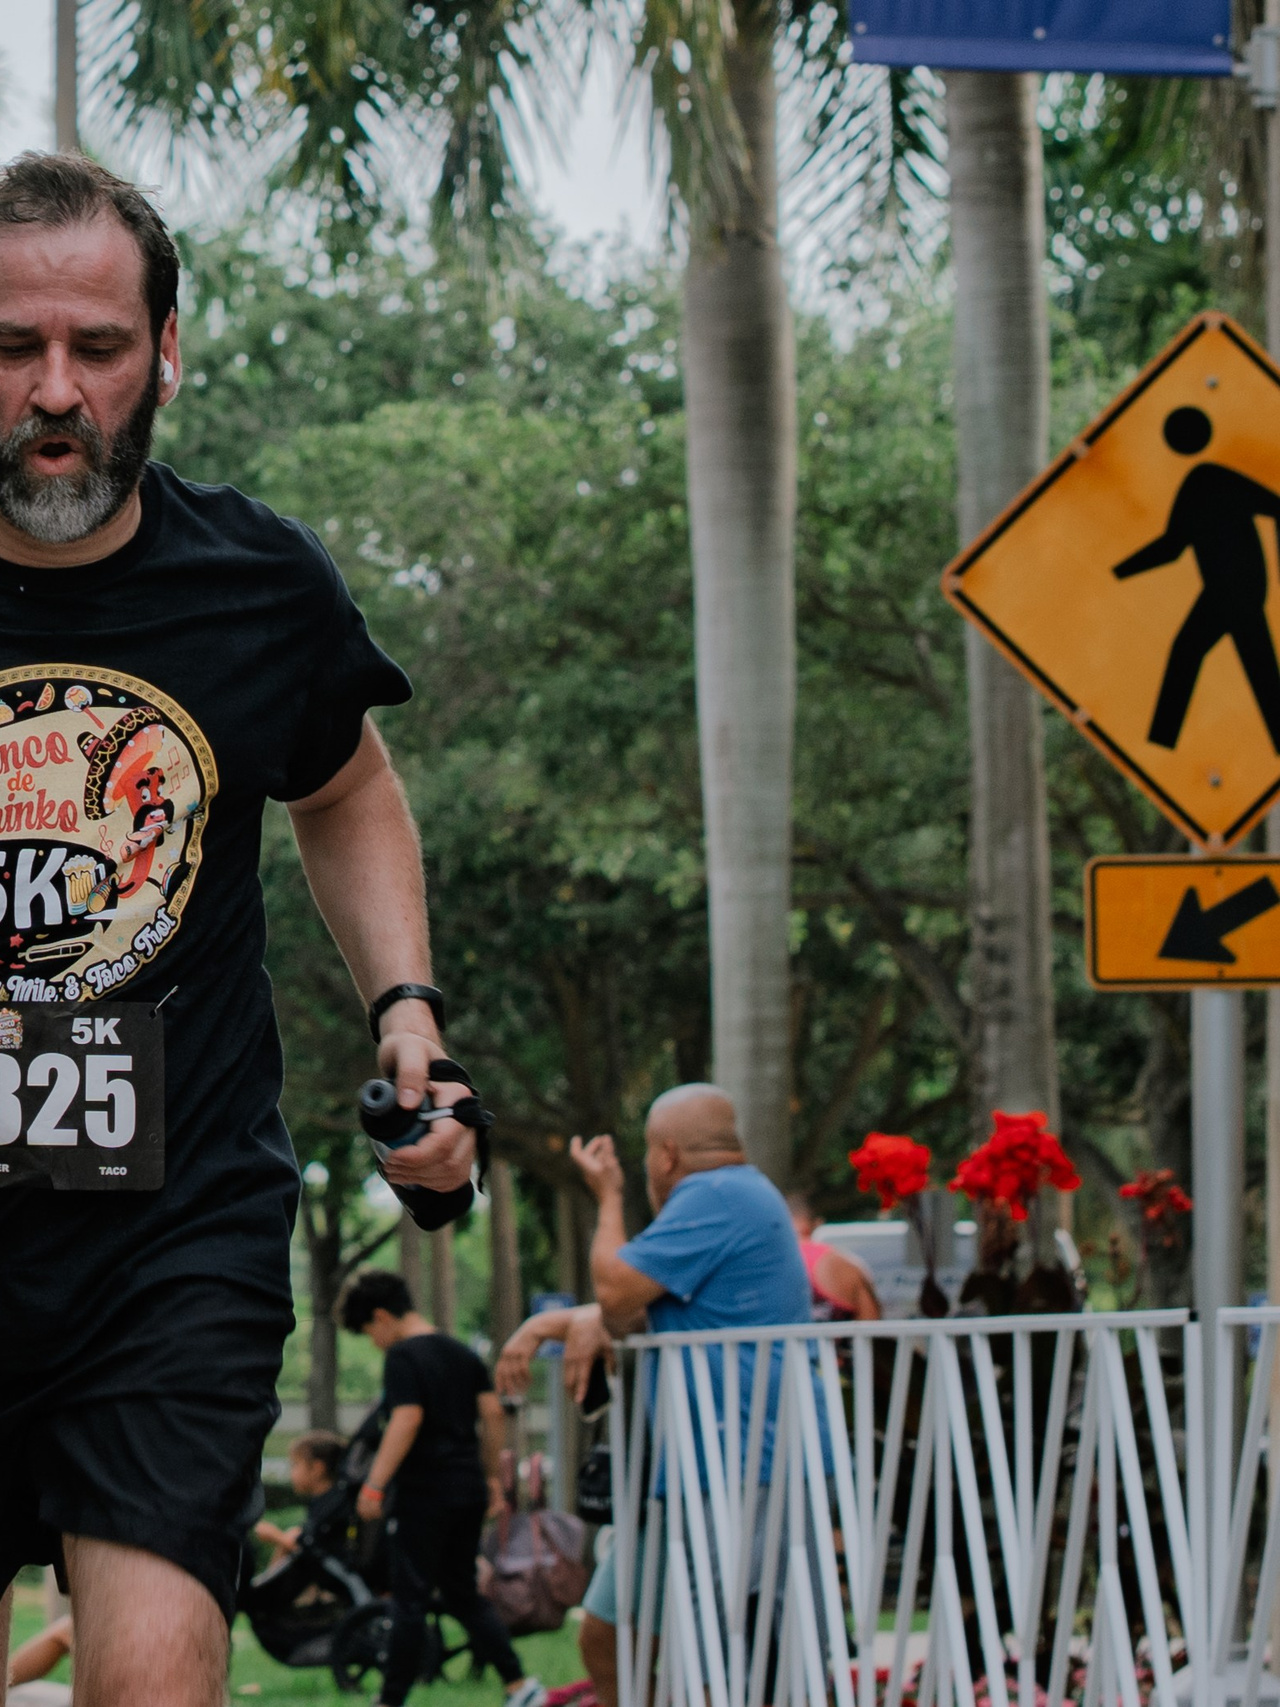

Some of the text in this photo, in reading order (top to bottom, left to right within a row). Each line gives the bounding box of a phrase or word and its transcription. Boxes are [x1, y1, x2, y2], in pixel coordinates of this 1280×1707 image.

[7, 770, 36, 793] de
[64, 975, 80, 1000] &
[86, 959, 138, 993] Taco
[71, 1017, 122, 1045] 5K
[98, 1166, 128, 1176] TACO
